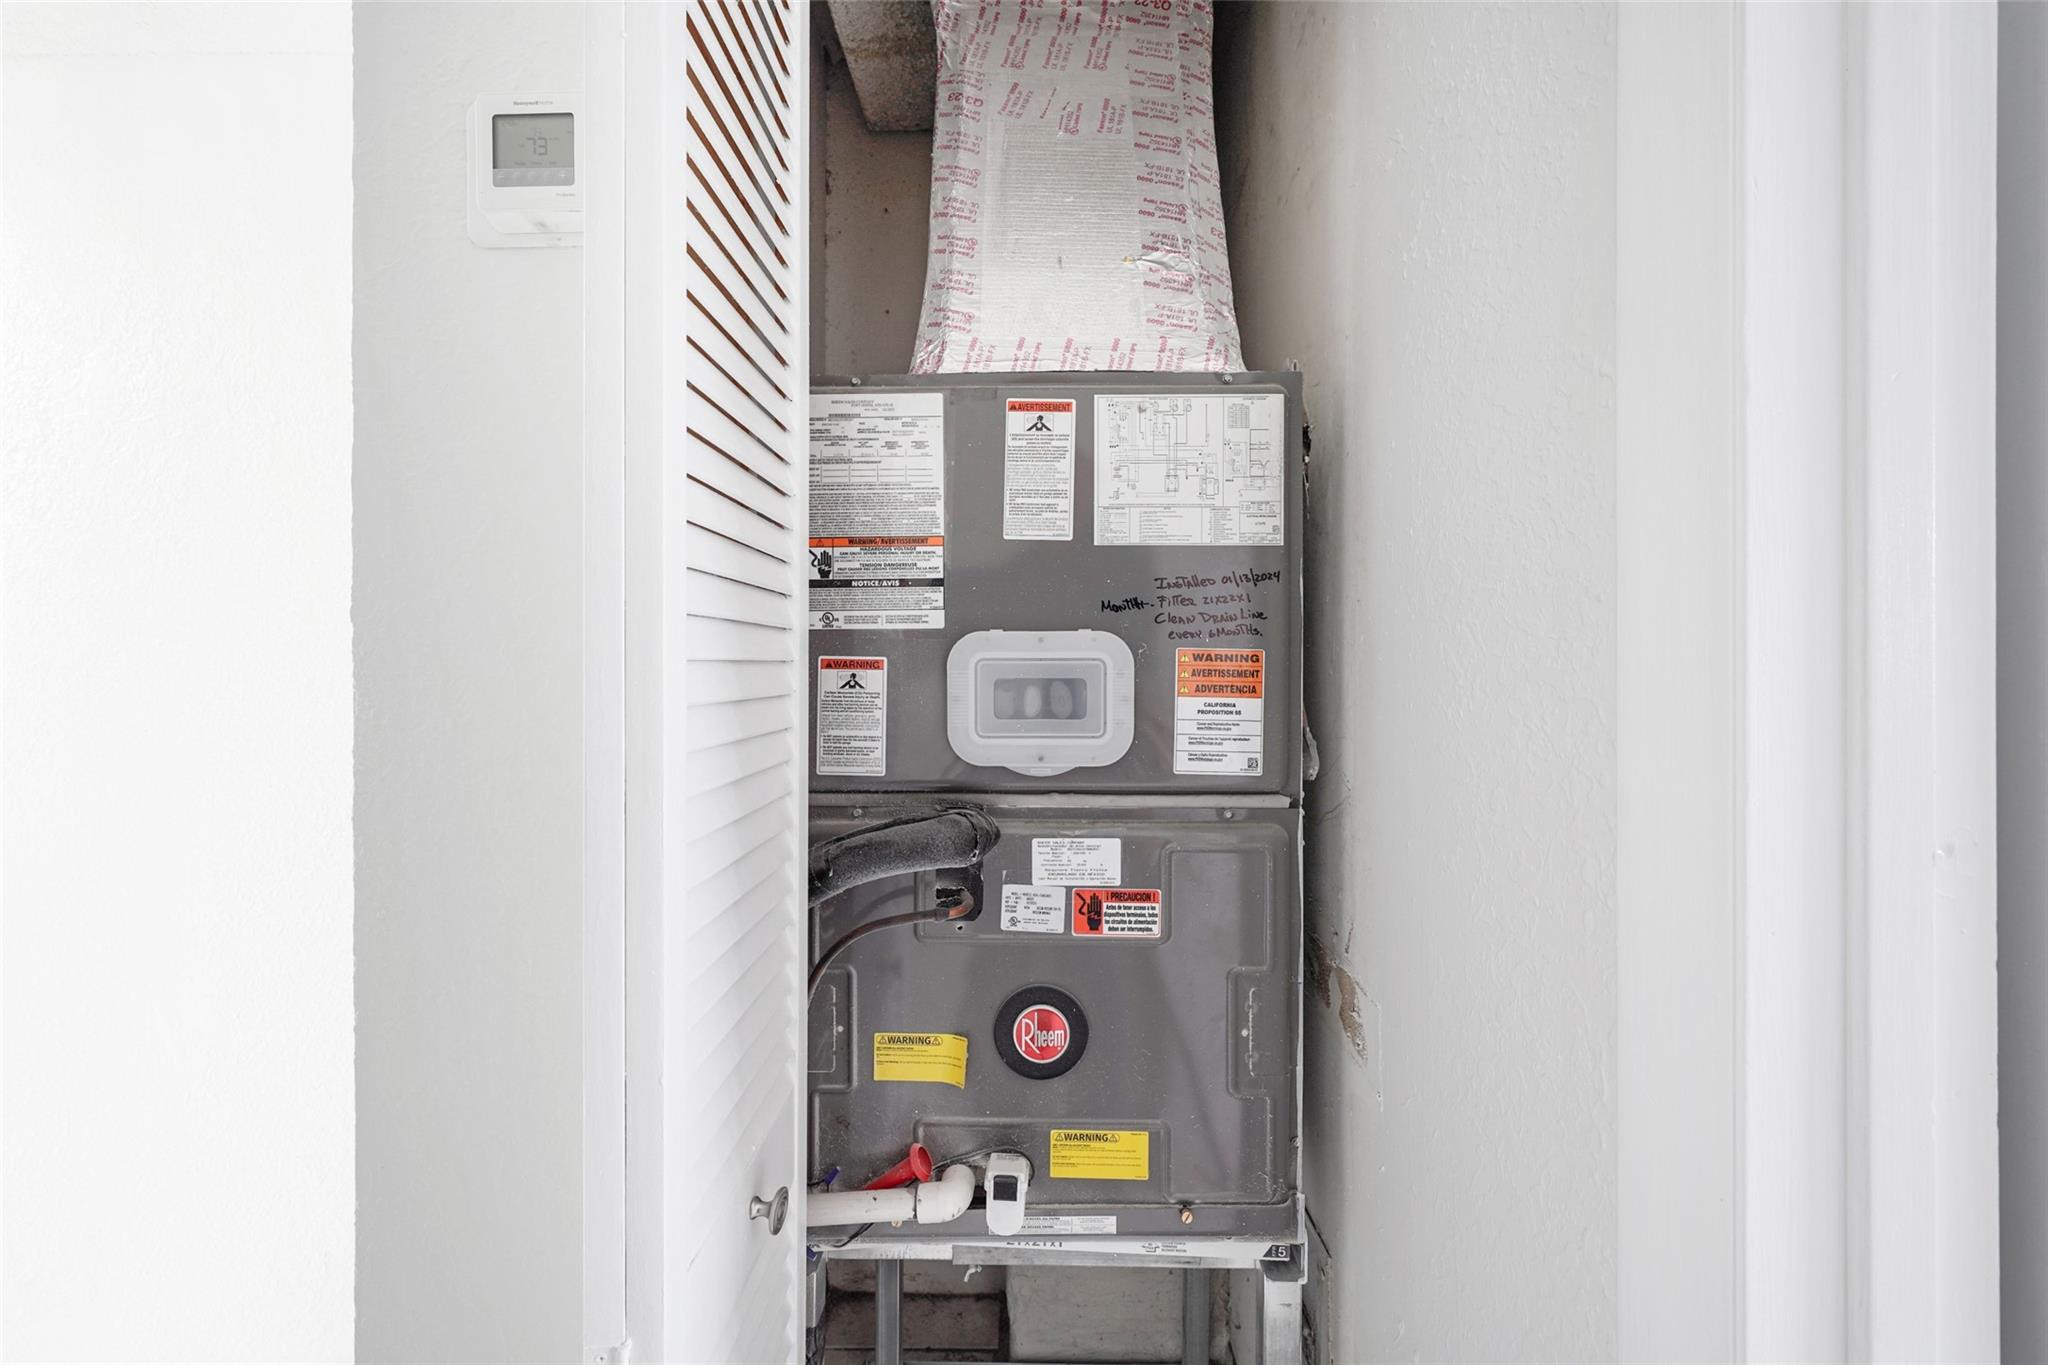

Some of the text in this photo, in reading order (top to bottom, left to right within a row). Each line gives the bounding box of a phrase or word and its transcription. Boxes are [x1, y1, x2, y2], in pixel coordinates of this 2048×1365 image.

[525, 136, 548, 155] 73
[1017, 401, 1071, 413] AVERTISSEMENT
[1221, 568, 1280, 588] 01/13/2024
[832, 658, 880, 669] WARNING
[1192, 653, 1260, 663] WARNING
[1190, 668, 1260, 679] AVERTISSEMENT
[1194, 684, 1257, 694] ADVERTENCIA
[1104, 911, 1126, 919] dispositivos
[1021, 1011, 1065, 1054] Rheem
[887, 1036, 931, 1045] WARNING
[1063, 1133, 1109, 1142] WARNING
[1278, 1246, 1286, 1257] 5
